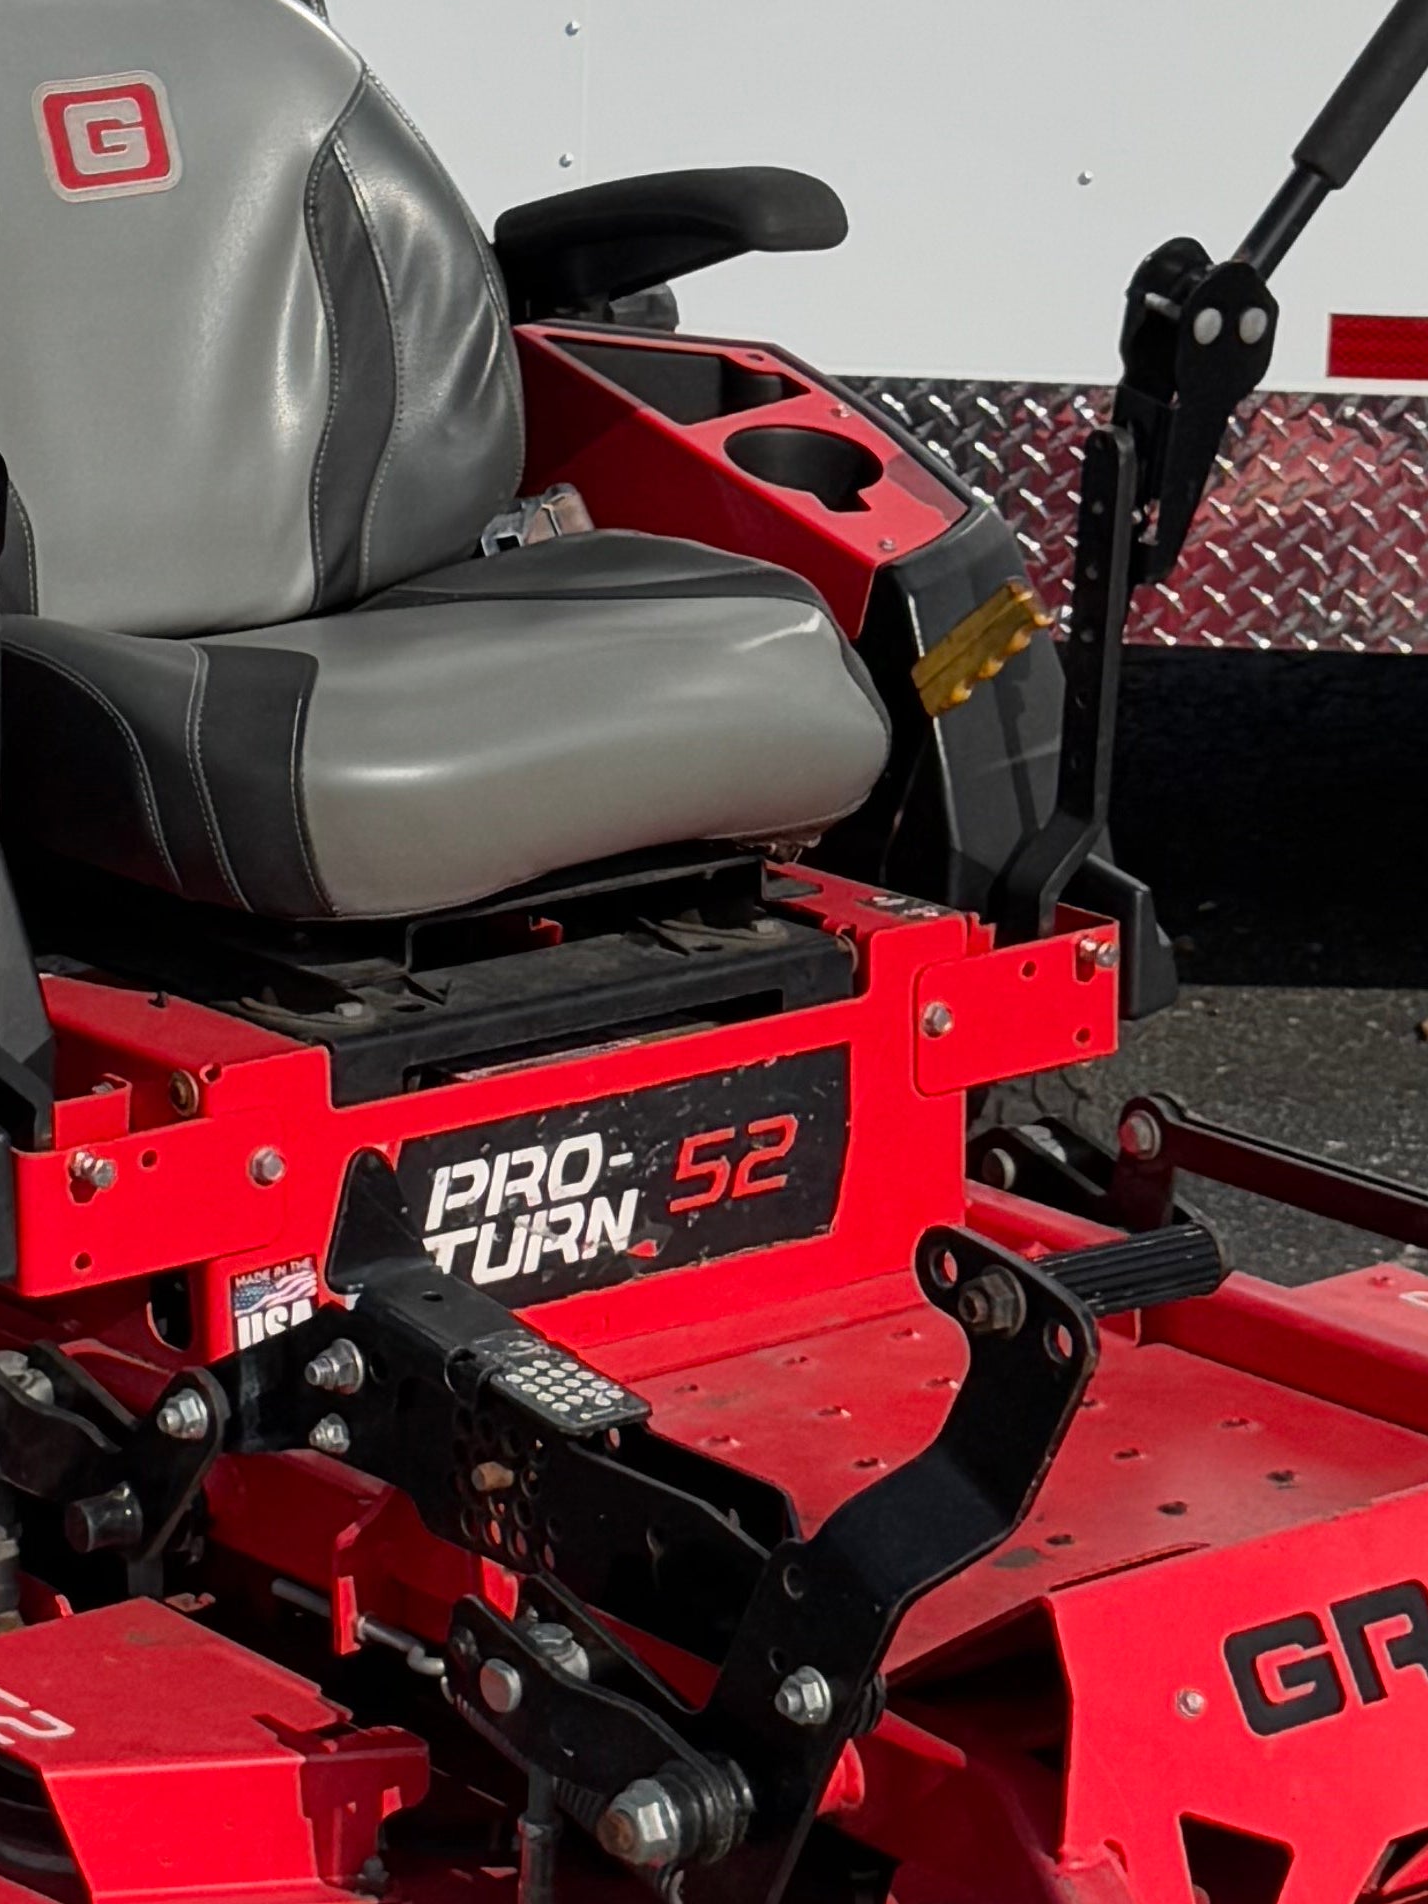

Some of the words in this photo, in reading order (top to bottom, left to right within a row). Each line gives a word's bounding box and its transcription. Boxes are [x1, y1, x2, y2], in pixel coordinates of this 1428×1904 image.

[63, 96, 151, 175] G
[424, 1132, 633, 1232] PRO-
[669, 1113, 799, 1213] 52
[234, 1268, 271, 1288] MADE
[273, 1265, 287, 1278] IN
[422, 1188, 640, 1286] TURN
